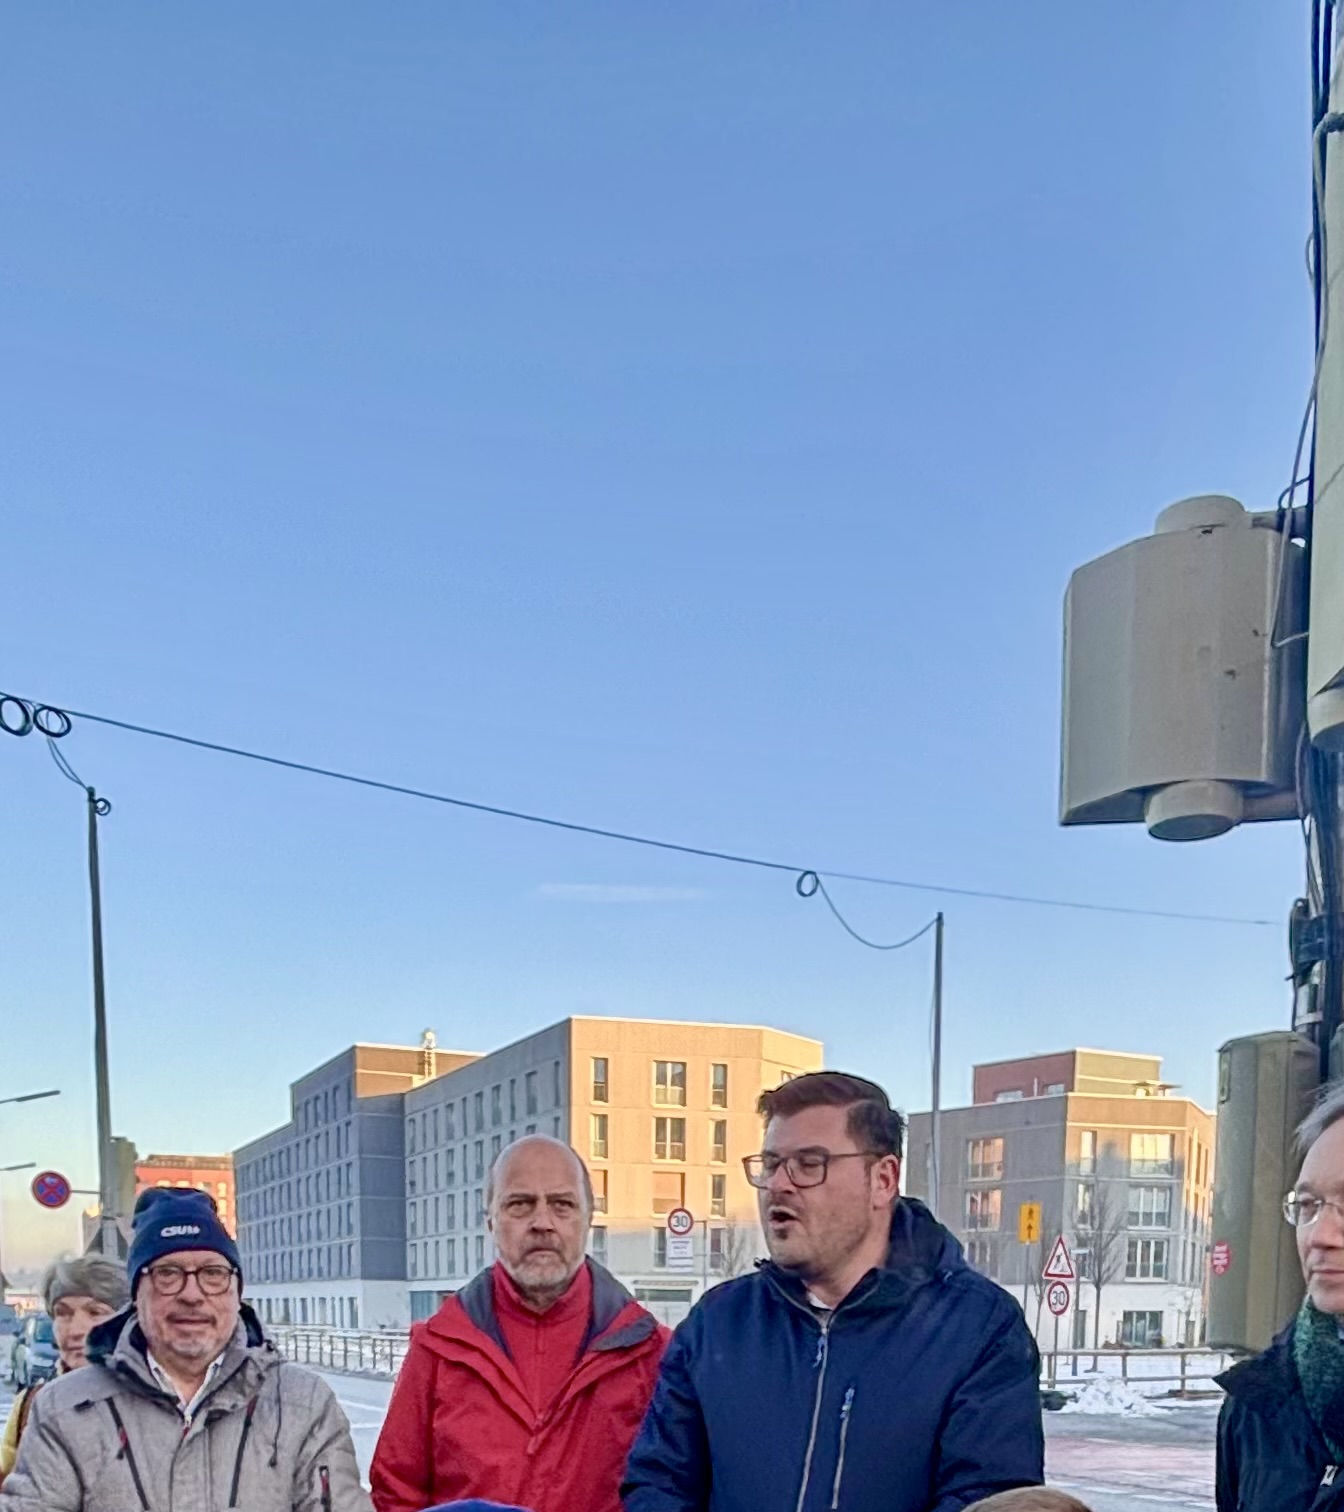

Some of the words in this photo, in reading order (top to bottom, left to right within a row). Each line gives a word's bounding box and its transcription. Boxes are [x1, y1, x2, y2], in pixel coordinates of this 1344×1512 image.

[672, 1215, 688, 1228] 30
[160, 1225, 187, 1238] CSU
[1051, 1290, 1066, 1306] 30
